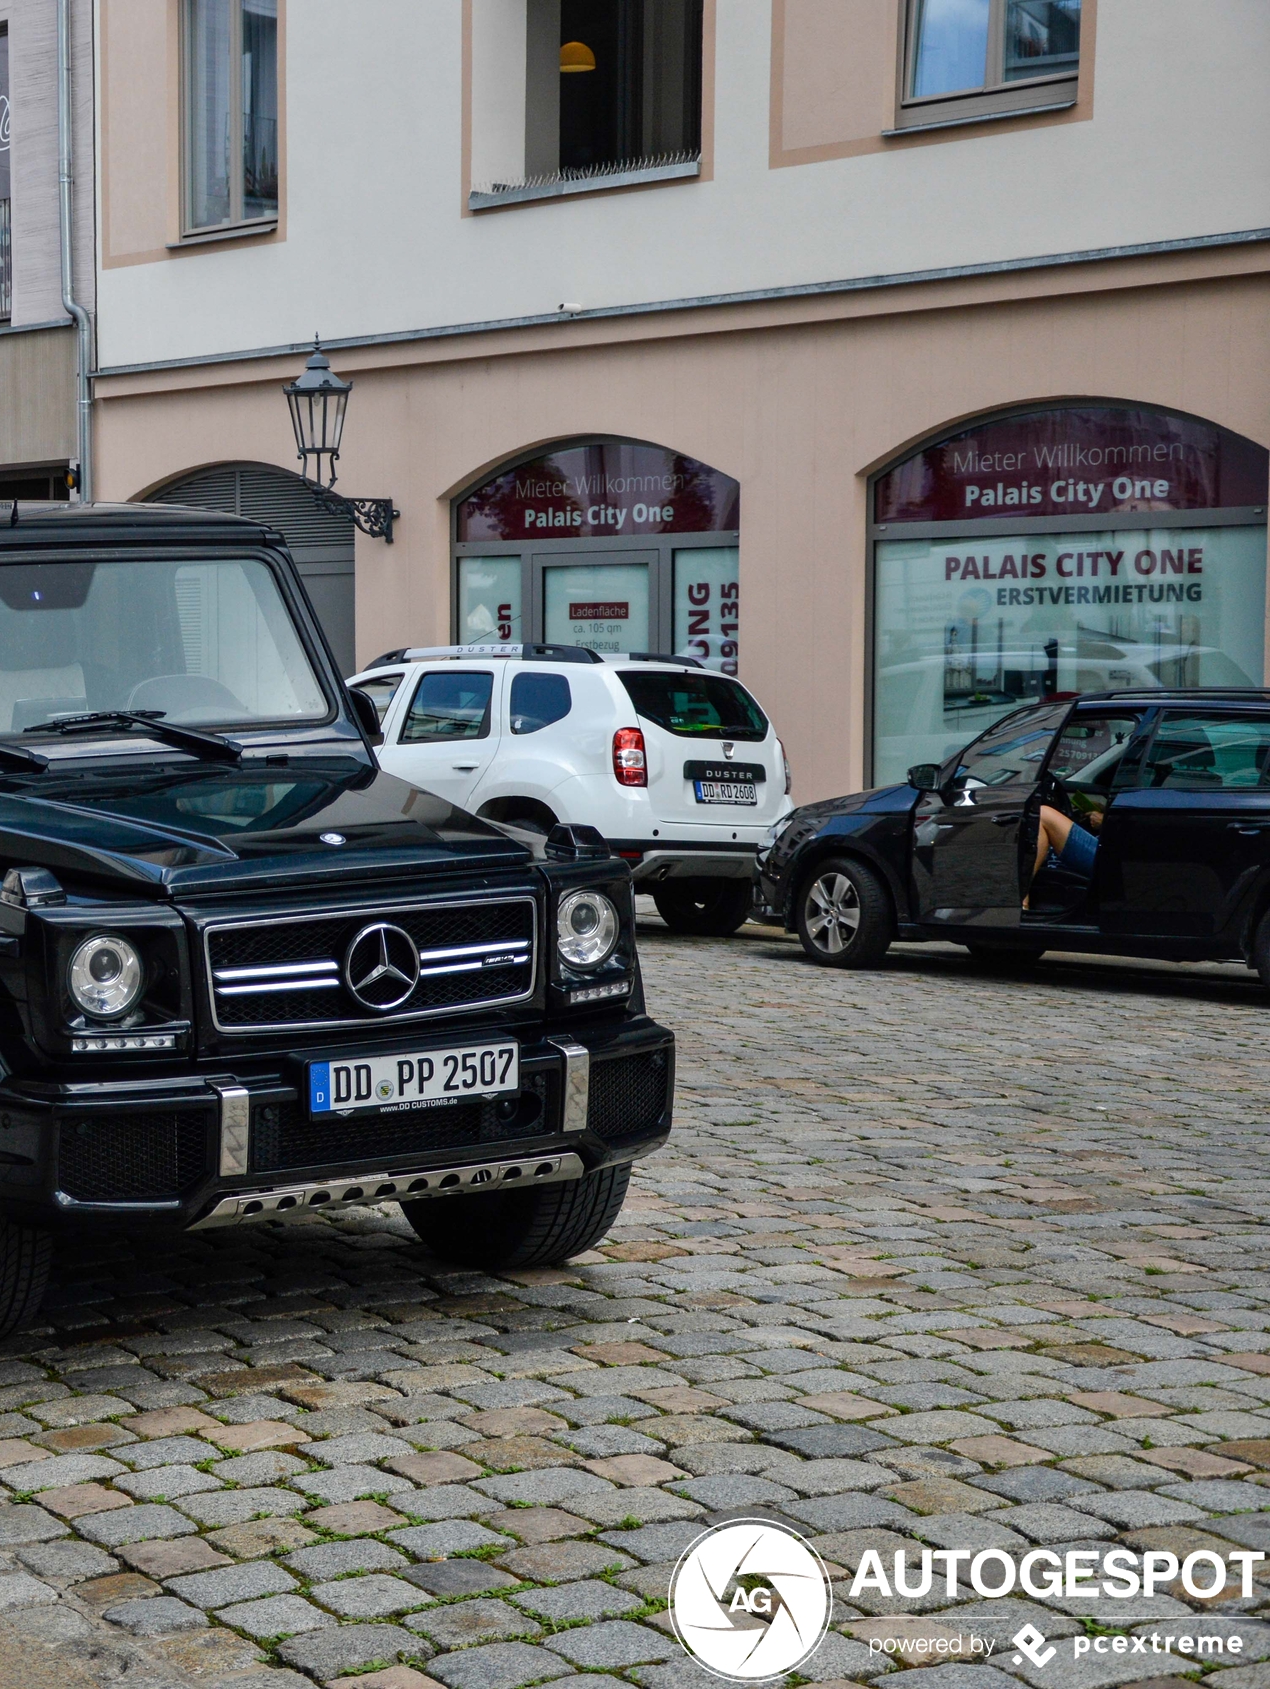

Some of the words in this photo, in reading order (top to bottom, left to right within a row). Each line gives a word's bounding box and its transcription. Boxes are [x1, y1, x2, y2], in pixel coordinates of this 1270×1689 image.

[953, 451, 1027, 474] Mieter
[1034, 443, 1184, 468] Willkommen
[515, 479, 570, 498] Mieter
[575, 473, 685, 496] Willkommen
[965, 480, 1043, 507] Palais
[1050, 478, 1104, 508] City
[1112, 476, 1170, 499] One
[524, 506, 582, 528] Palais
[587, 503, 628, 530] City
[632, 502, 675, 523] One
[945, 552, 1047, 581] PALAIS
[1056, 550, 1125, 578] CITY
[1134, 548, 1204, 576] ONE
[996, 581, 1203, 606] ERSTVERMIETUNG
[571, 606, 627, 617] Ladenfläche
[573, 624, 586, 634] ca.
[589, 623, 605, 634] 105
[607, 624, 622, 635] qm
[575, 639, 620, 653] Erstbezug
[706, 771, 753, 779] DUSTER
[702, 783, 715, 798] DD
[720, 784, 733, 799] RD
[733, 785, 755, 800] 2608
[334, 1064, 372, 1103] DD
[397, 1057, 434, 1096] PP
[443, 1048, 514, 1092] 2507
[316, 1091, 325, 1103] D
[411, 1097, 458, 1109] CUSTOMS.de
